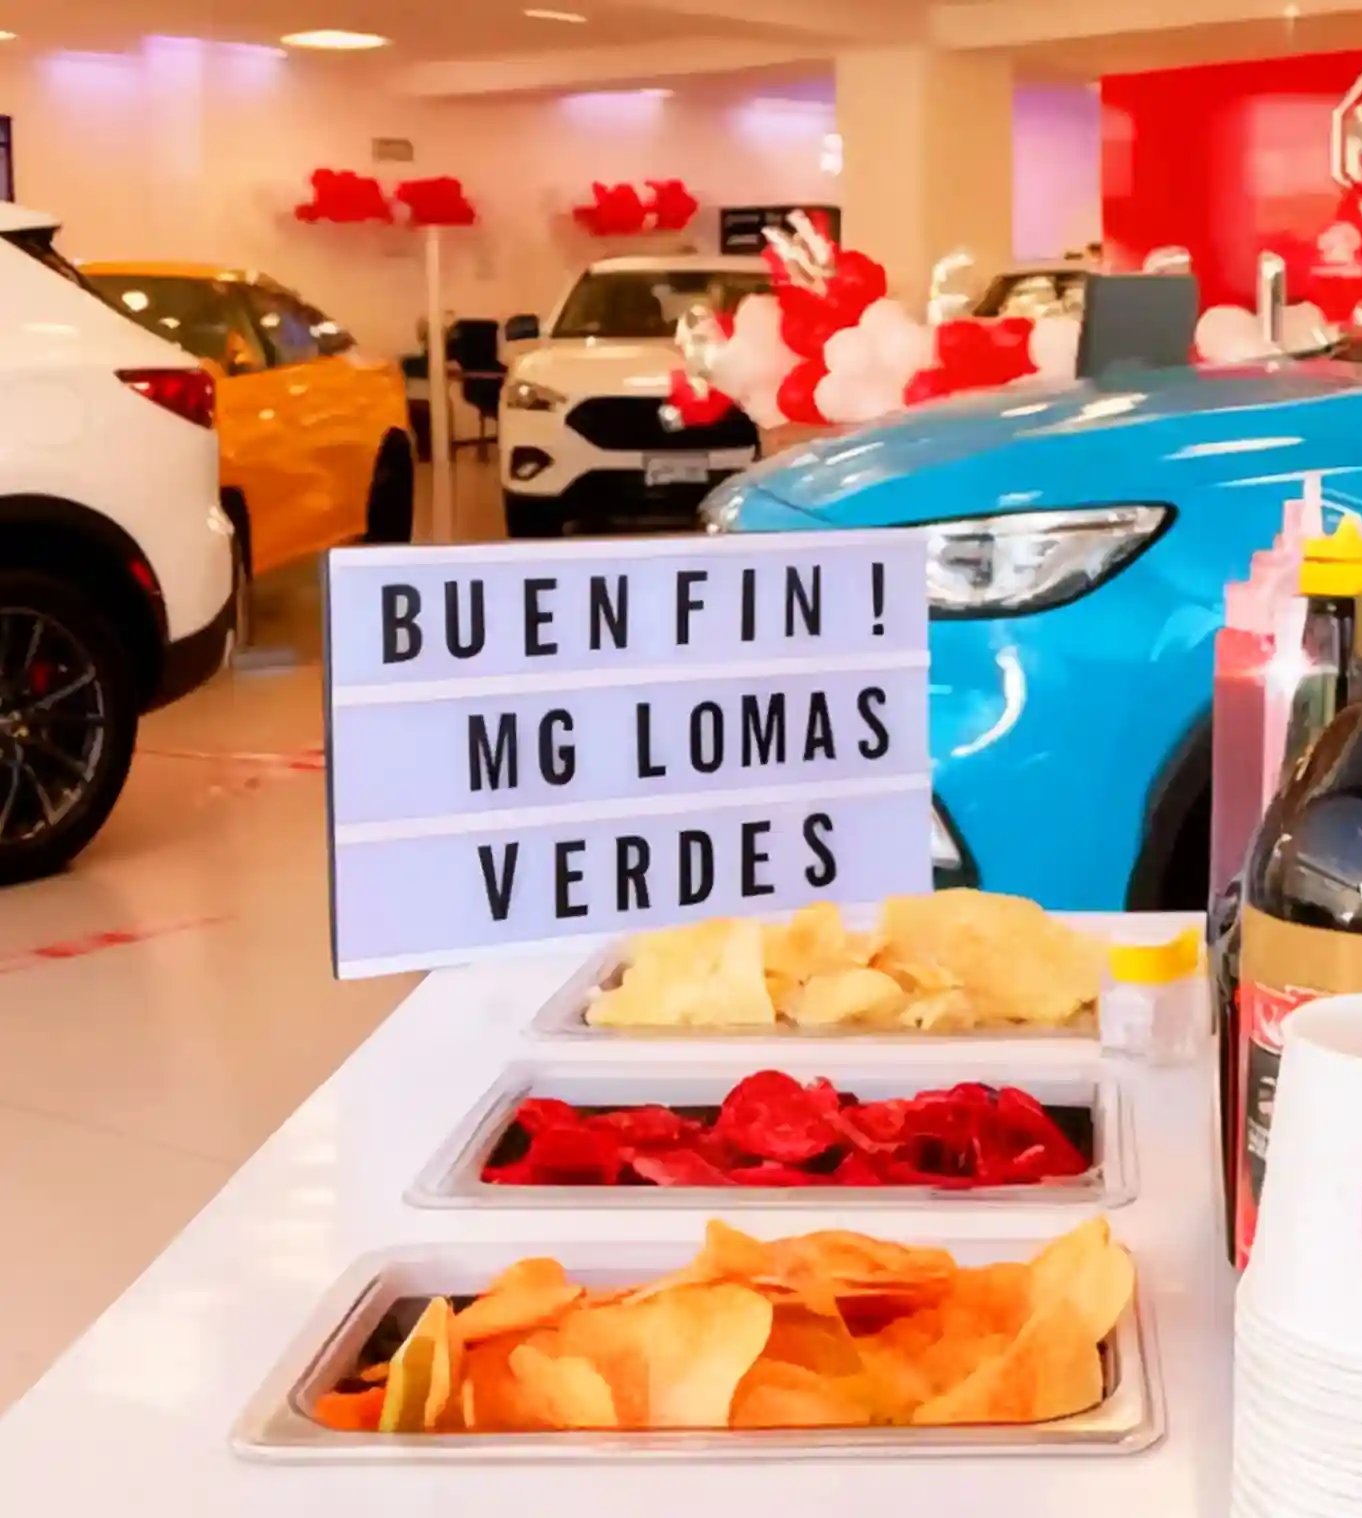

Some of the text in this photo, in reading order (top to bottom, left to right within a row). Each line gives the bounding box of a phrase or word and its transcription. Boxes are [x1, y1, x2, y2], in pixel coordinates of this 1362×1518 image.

[382, 575, 627, 663] BUEN
[469, 687, 889, 791] MG LOMAS
[478, 813, 836, 921] VERDES
